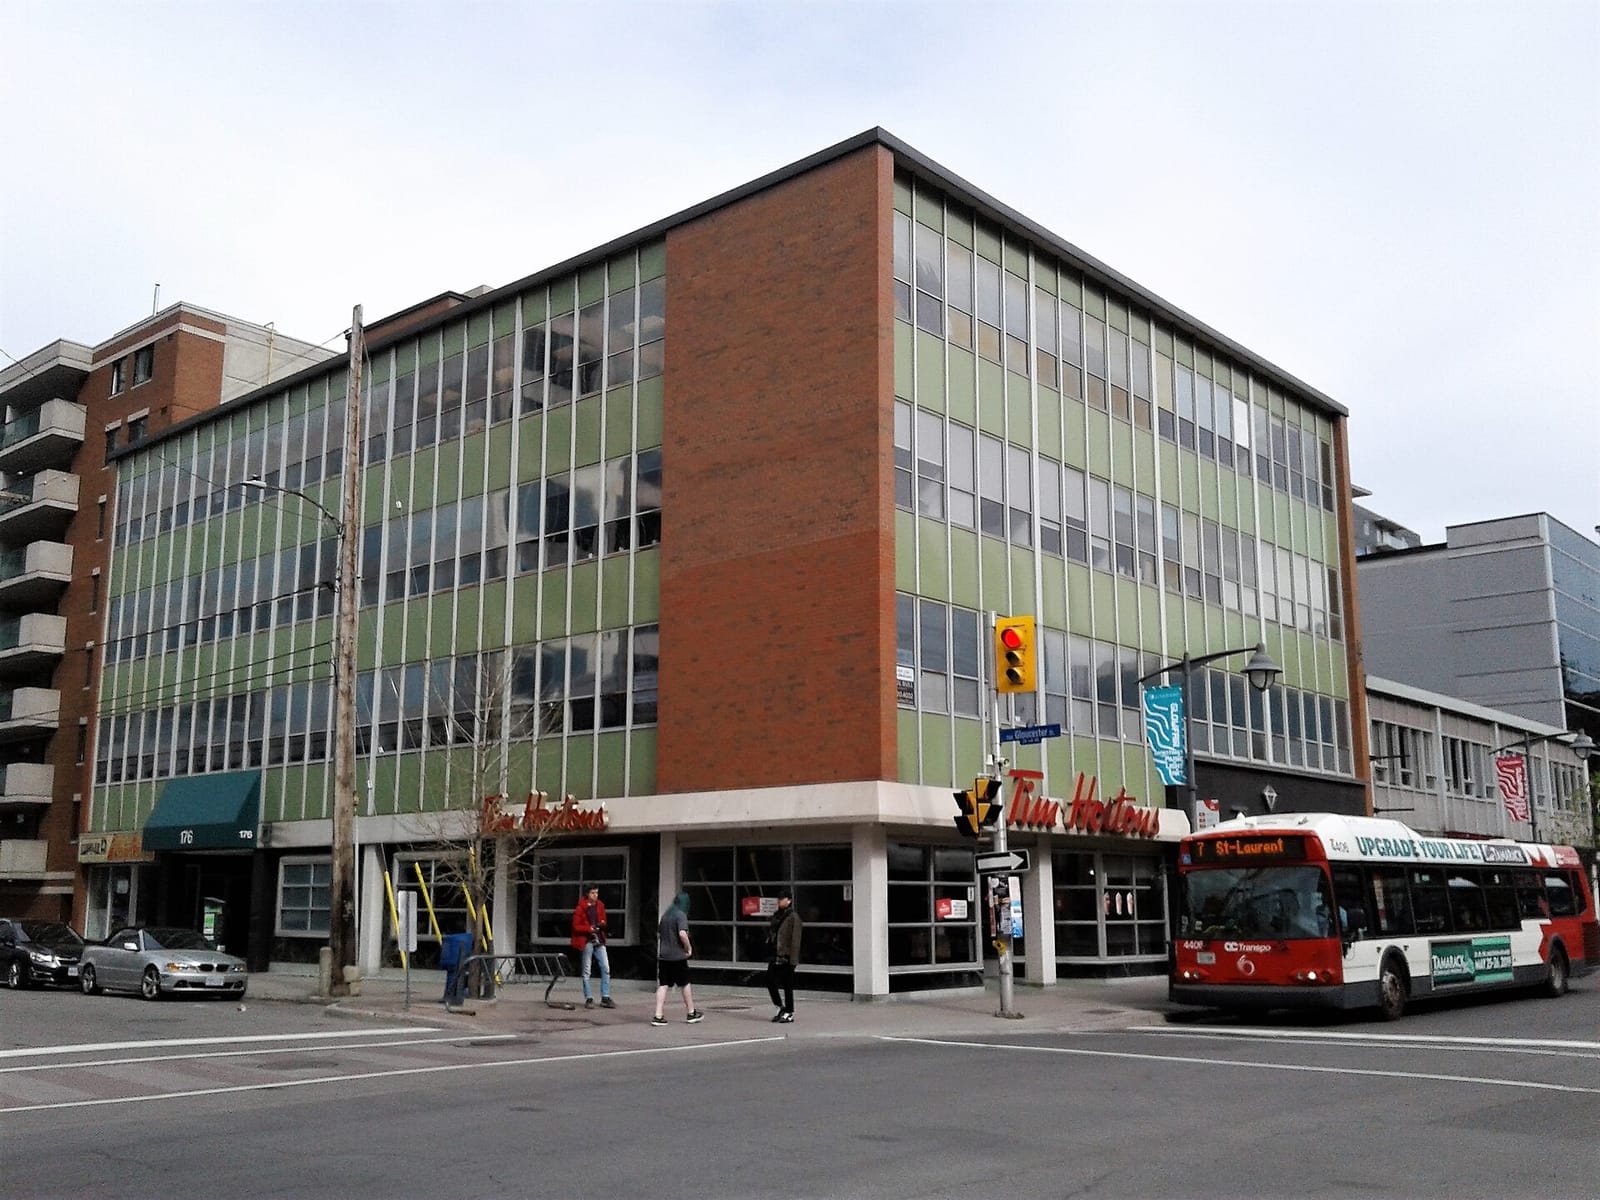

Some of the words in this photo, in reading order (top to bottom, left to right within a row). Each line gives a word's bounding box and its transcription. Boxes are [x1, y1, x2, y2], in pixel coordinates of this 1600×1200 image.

[1014, 729, 1048, 740] Gloucester
[523, 790, 608, 831] Hortons
[1008, 769, 1058, 826] Tim
[1067, 771, 1160, 838] Hortons
[180, 830, 194, 845] 176
[239, 830, 253, 839] 176
[1197, 842, 1204, 857] 7
[1215, 837, 1285, 856] St-Laurent
[1355, 835, 1419, 858] UPGRADE
[1419, 841, 1453, 859] YOUR
[1239, 943, 1272, 953] Transpo
